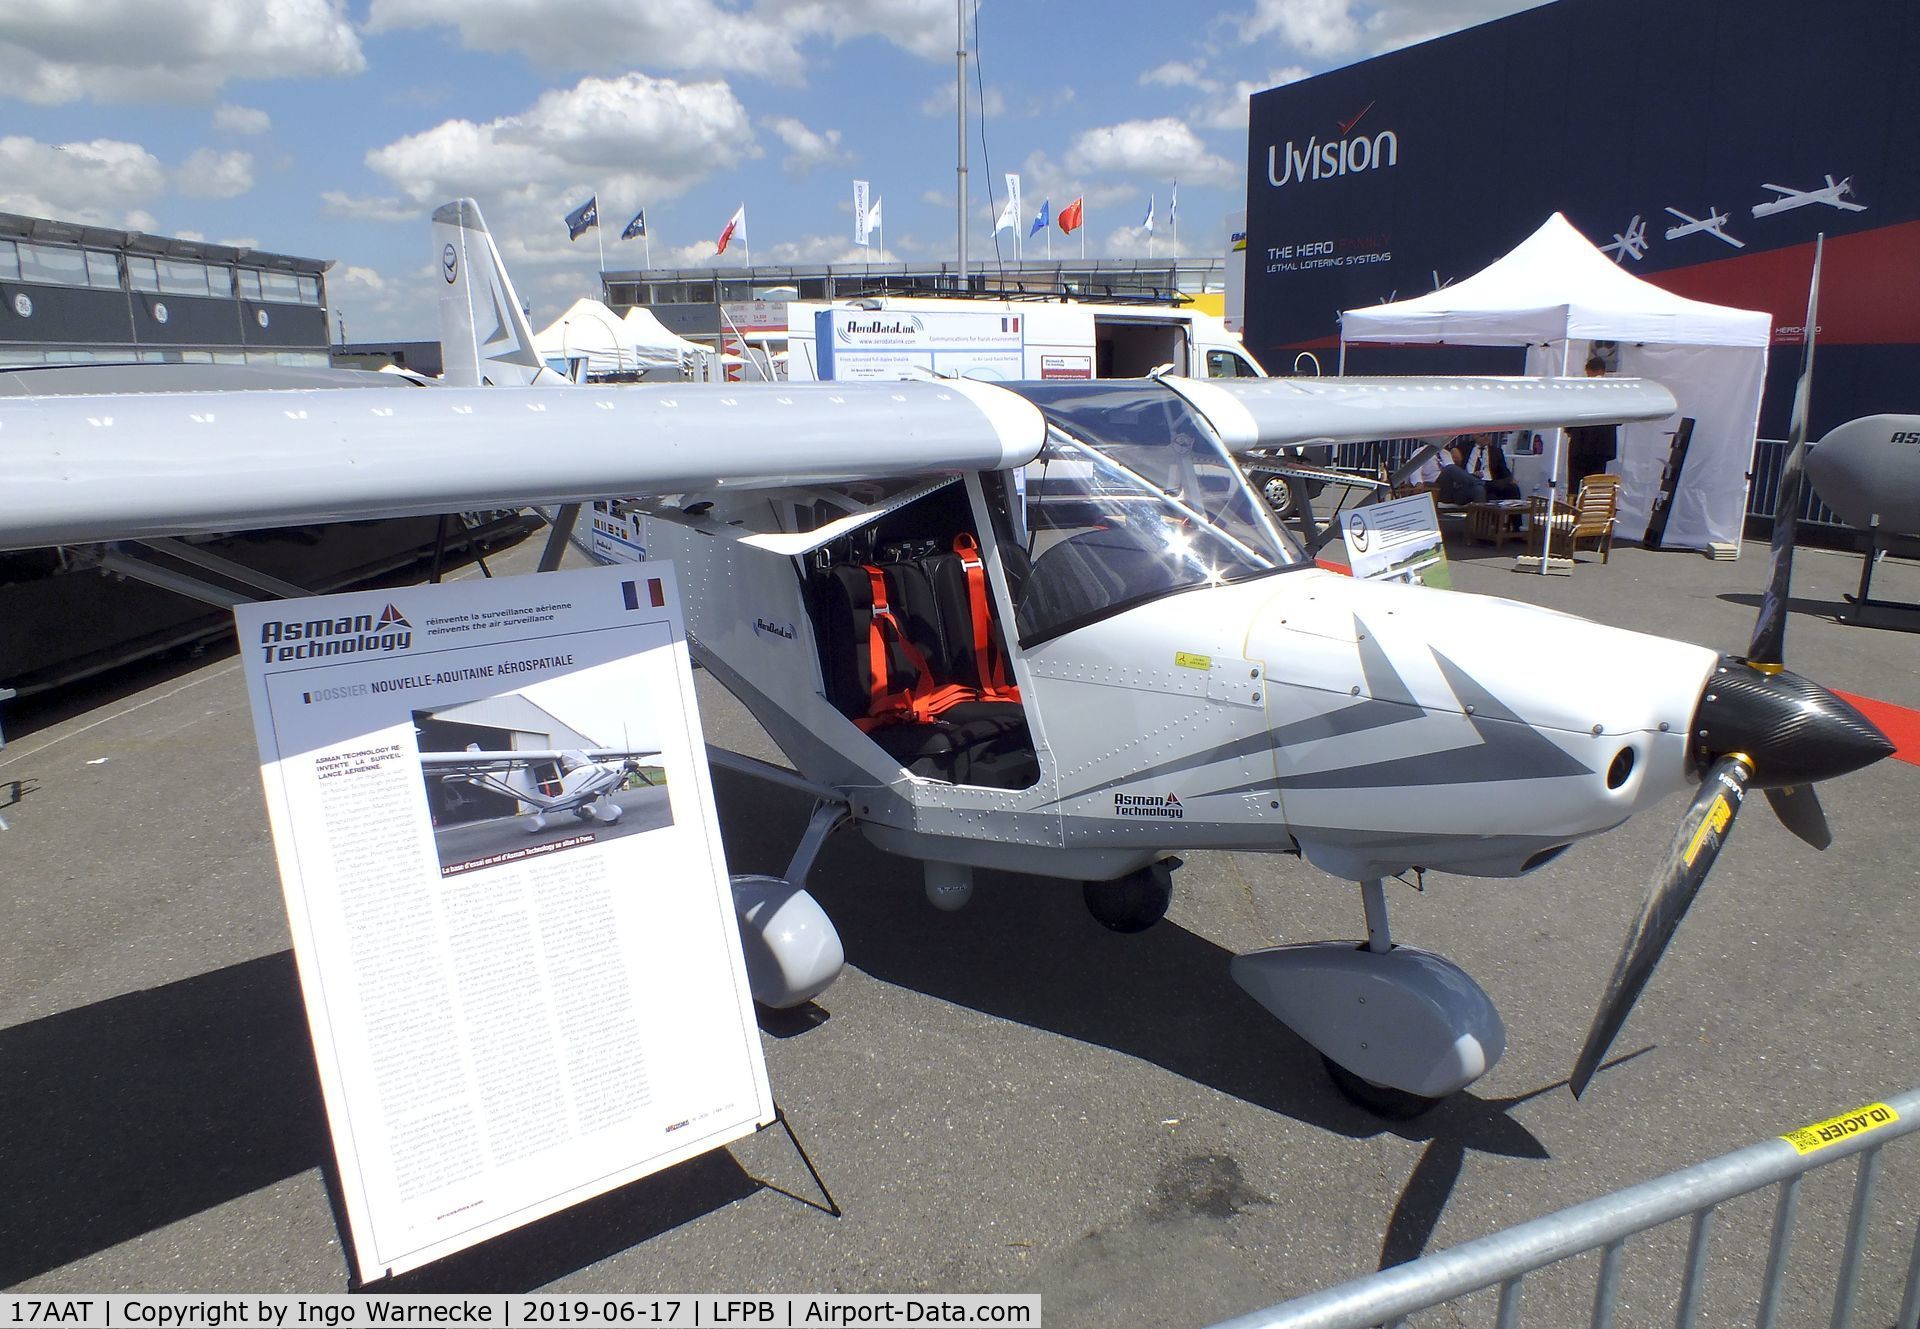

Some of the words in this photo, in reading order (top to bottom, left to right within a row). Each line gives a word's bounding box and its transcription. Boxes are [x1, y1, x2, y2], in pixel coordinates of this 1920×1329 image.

[1268, 246, 1292, 260] THE
[1296, 241, 1333, 257] HERO
[1266, 262, 1297, 273] LETHAL
[1300, 257, 1344, 270] LOITERING
[1346, 252, 1392, 265] SYSTEMS
[847, 321, 916, 334] AeroDataLink
[1891, 432, 1920, 444] AS
[426, 614, 469, 626] réinvente
[482, 606, 534, 619] surveillance
[535, 602, 572, 613] aérienne
[261, 615, 373, 644] Asman
[427, 624, 470, 636] reinvents
[472, 622, 487, 630] the
[489, 620, 501, 628] air
[503, 614, 554, 627] surveillance
[262, 631, 412, 664] Technology
[314, 684, 367, 702] DOSSIER
[371, 666, 494, 693] NOUVELLE-AQUITAINE
[497, 654, 574, 675] AÉROSPATIALE
[315, 755, 341, 764] ASMAN
[342, 746, 389, 759] TECHNOLOGY
[316, 761, 349, 772] INVENTE
[318, 771, 342, 780] LANCE
[1114, 793, 1164, 806] Asman
[1115, 805, 1183, 819] Technology
[450, 865, 464, 873] base
[526, 844, 555, 856] Technology
[1818, 1107, 1890, 1142] ID.ACIER
